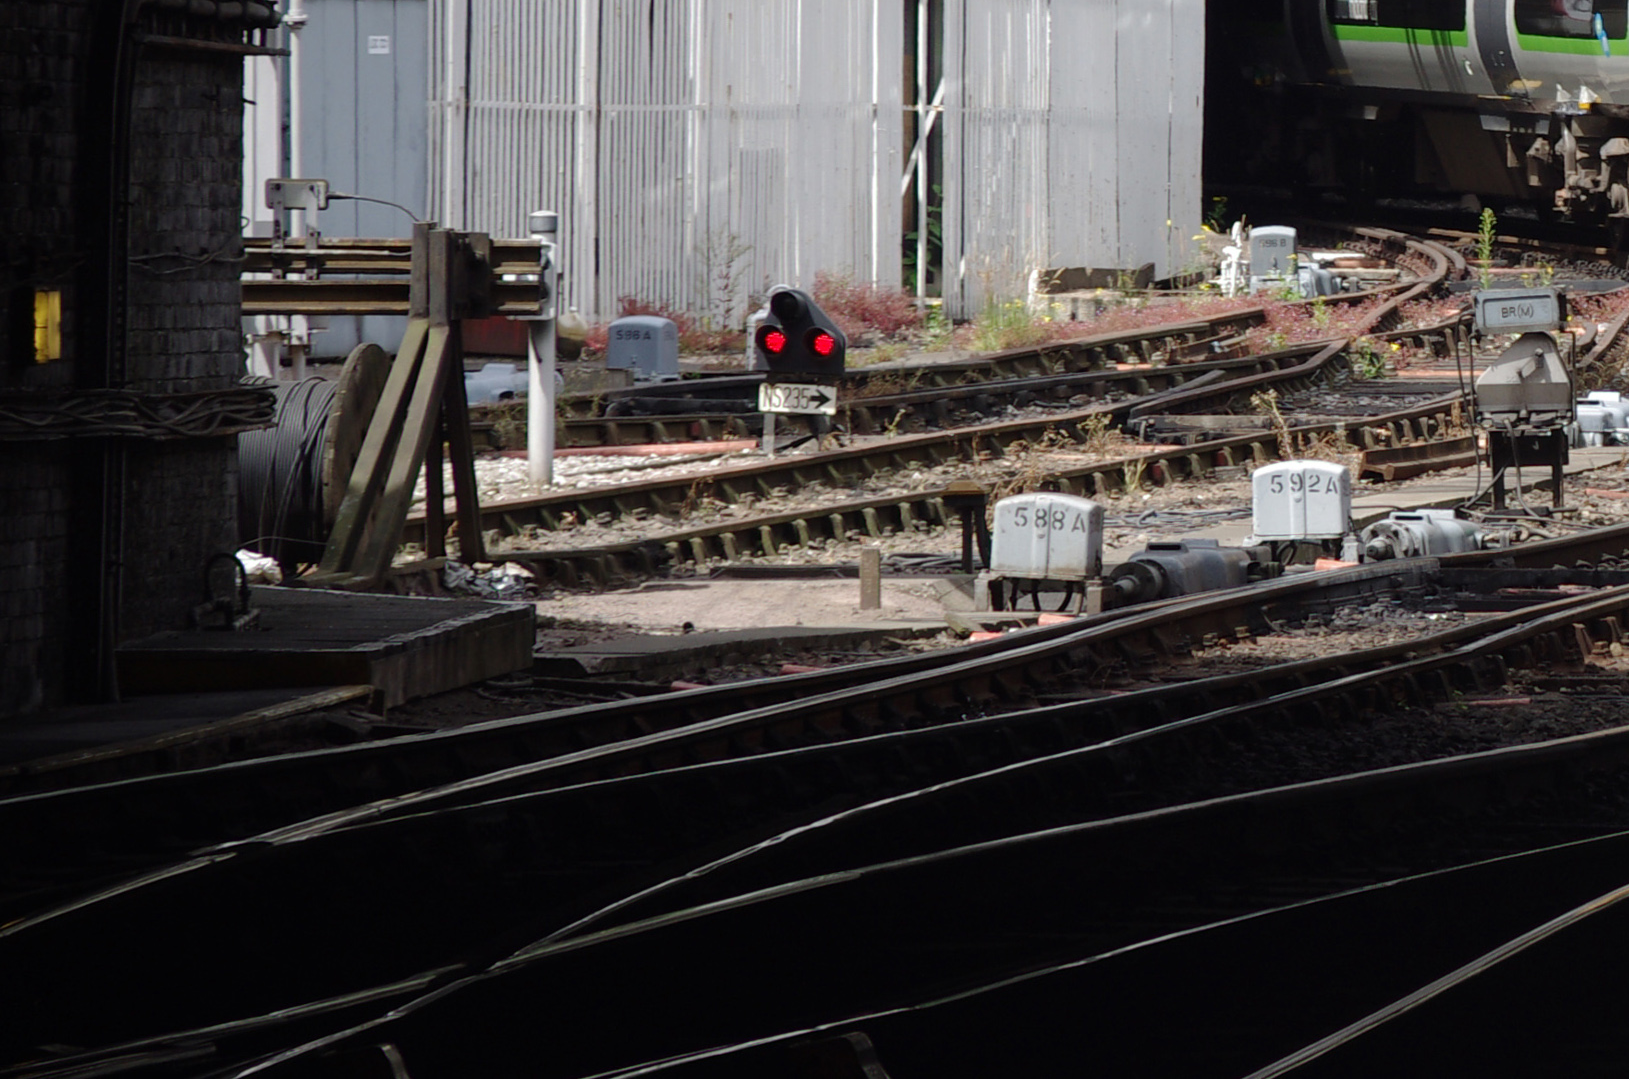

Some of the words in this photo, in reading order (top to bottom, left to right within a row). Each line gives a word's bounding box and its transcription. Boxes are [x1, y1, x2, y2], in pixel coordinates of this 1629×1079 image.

[1501, 303, 1535, 319] BR(M)
[763, 385, 811, 409] NS235
[1271, 473, 1338, 494] 592A
[1014, 507, 1086, 533] 588A
